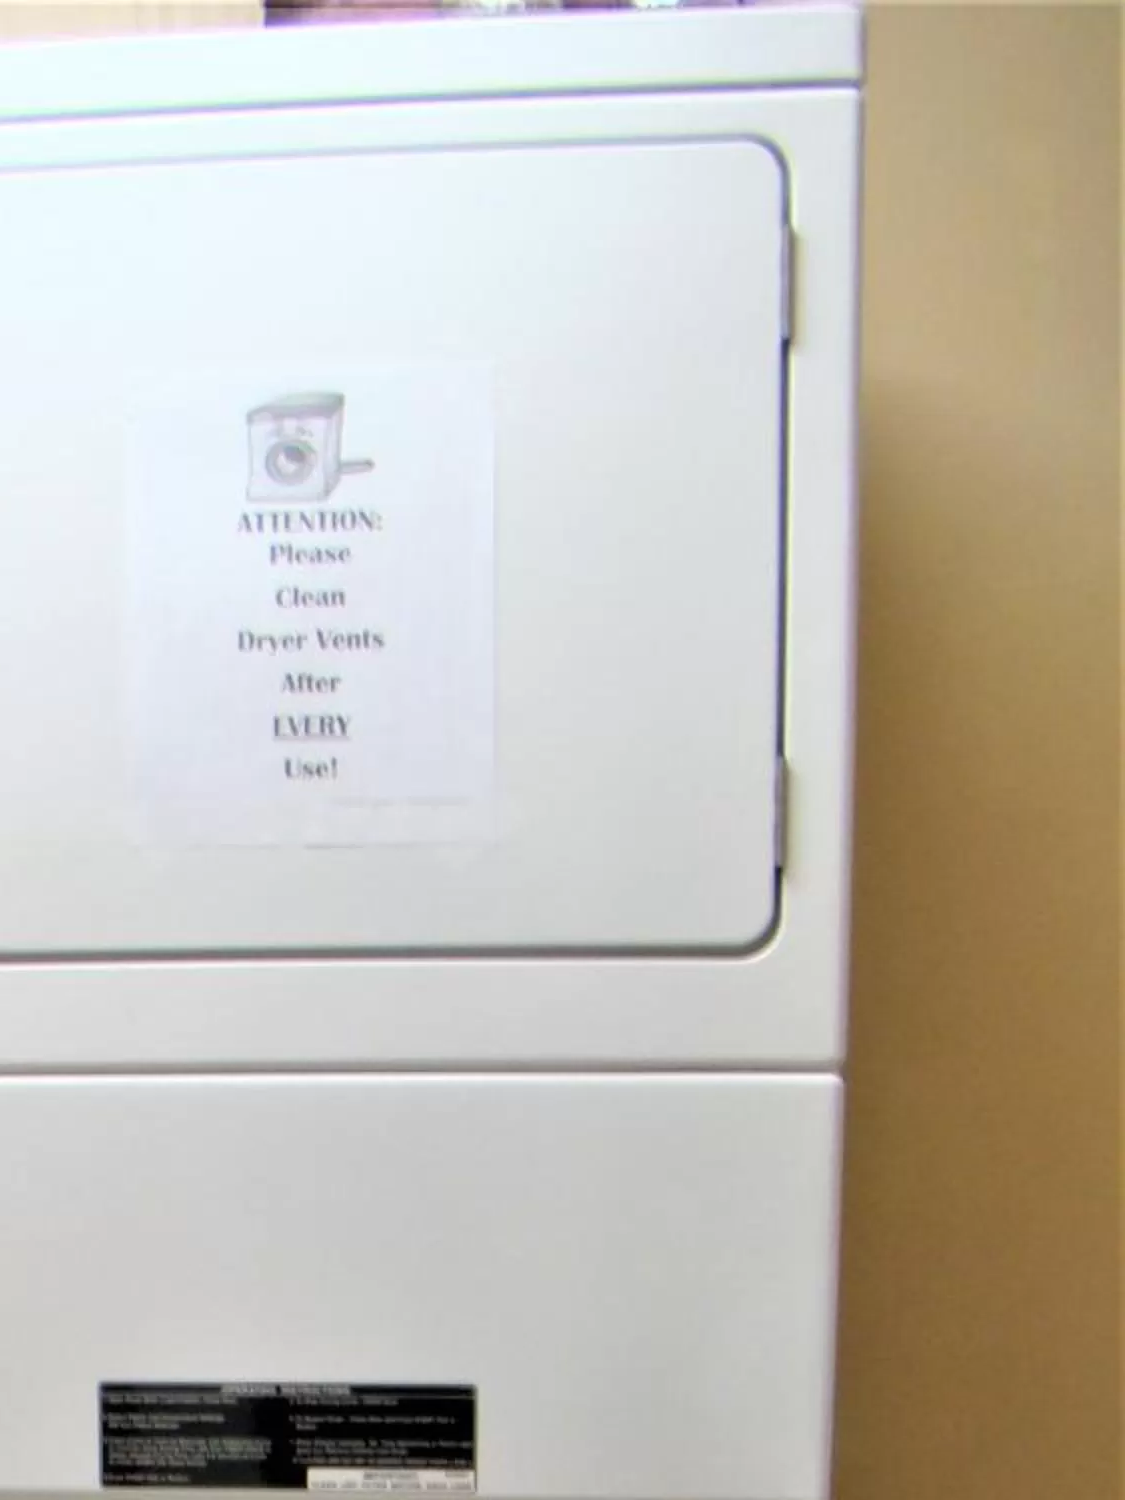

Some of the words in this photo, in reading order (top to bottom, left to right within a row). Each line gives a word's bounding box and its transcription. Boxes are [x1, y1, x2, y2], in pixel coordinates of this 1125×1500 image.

[237, 508, 384, 534] ATTENTION:
[269, 542, 352, 566] Please
[275, 585, 347, 609] Clean
[237, 629, 308, 657] Dryer
[315, 627, 386, 652] Vents
[281, 671, 343, 695] After
[272, 713, 351, 740] EVERY
[284, 755, 339, 781] Use!
